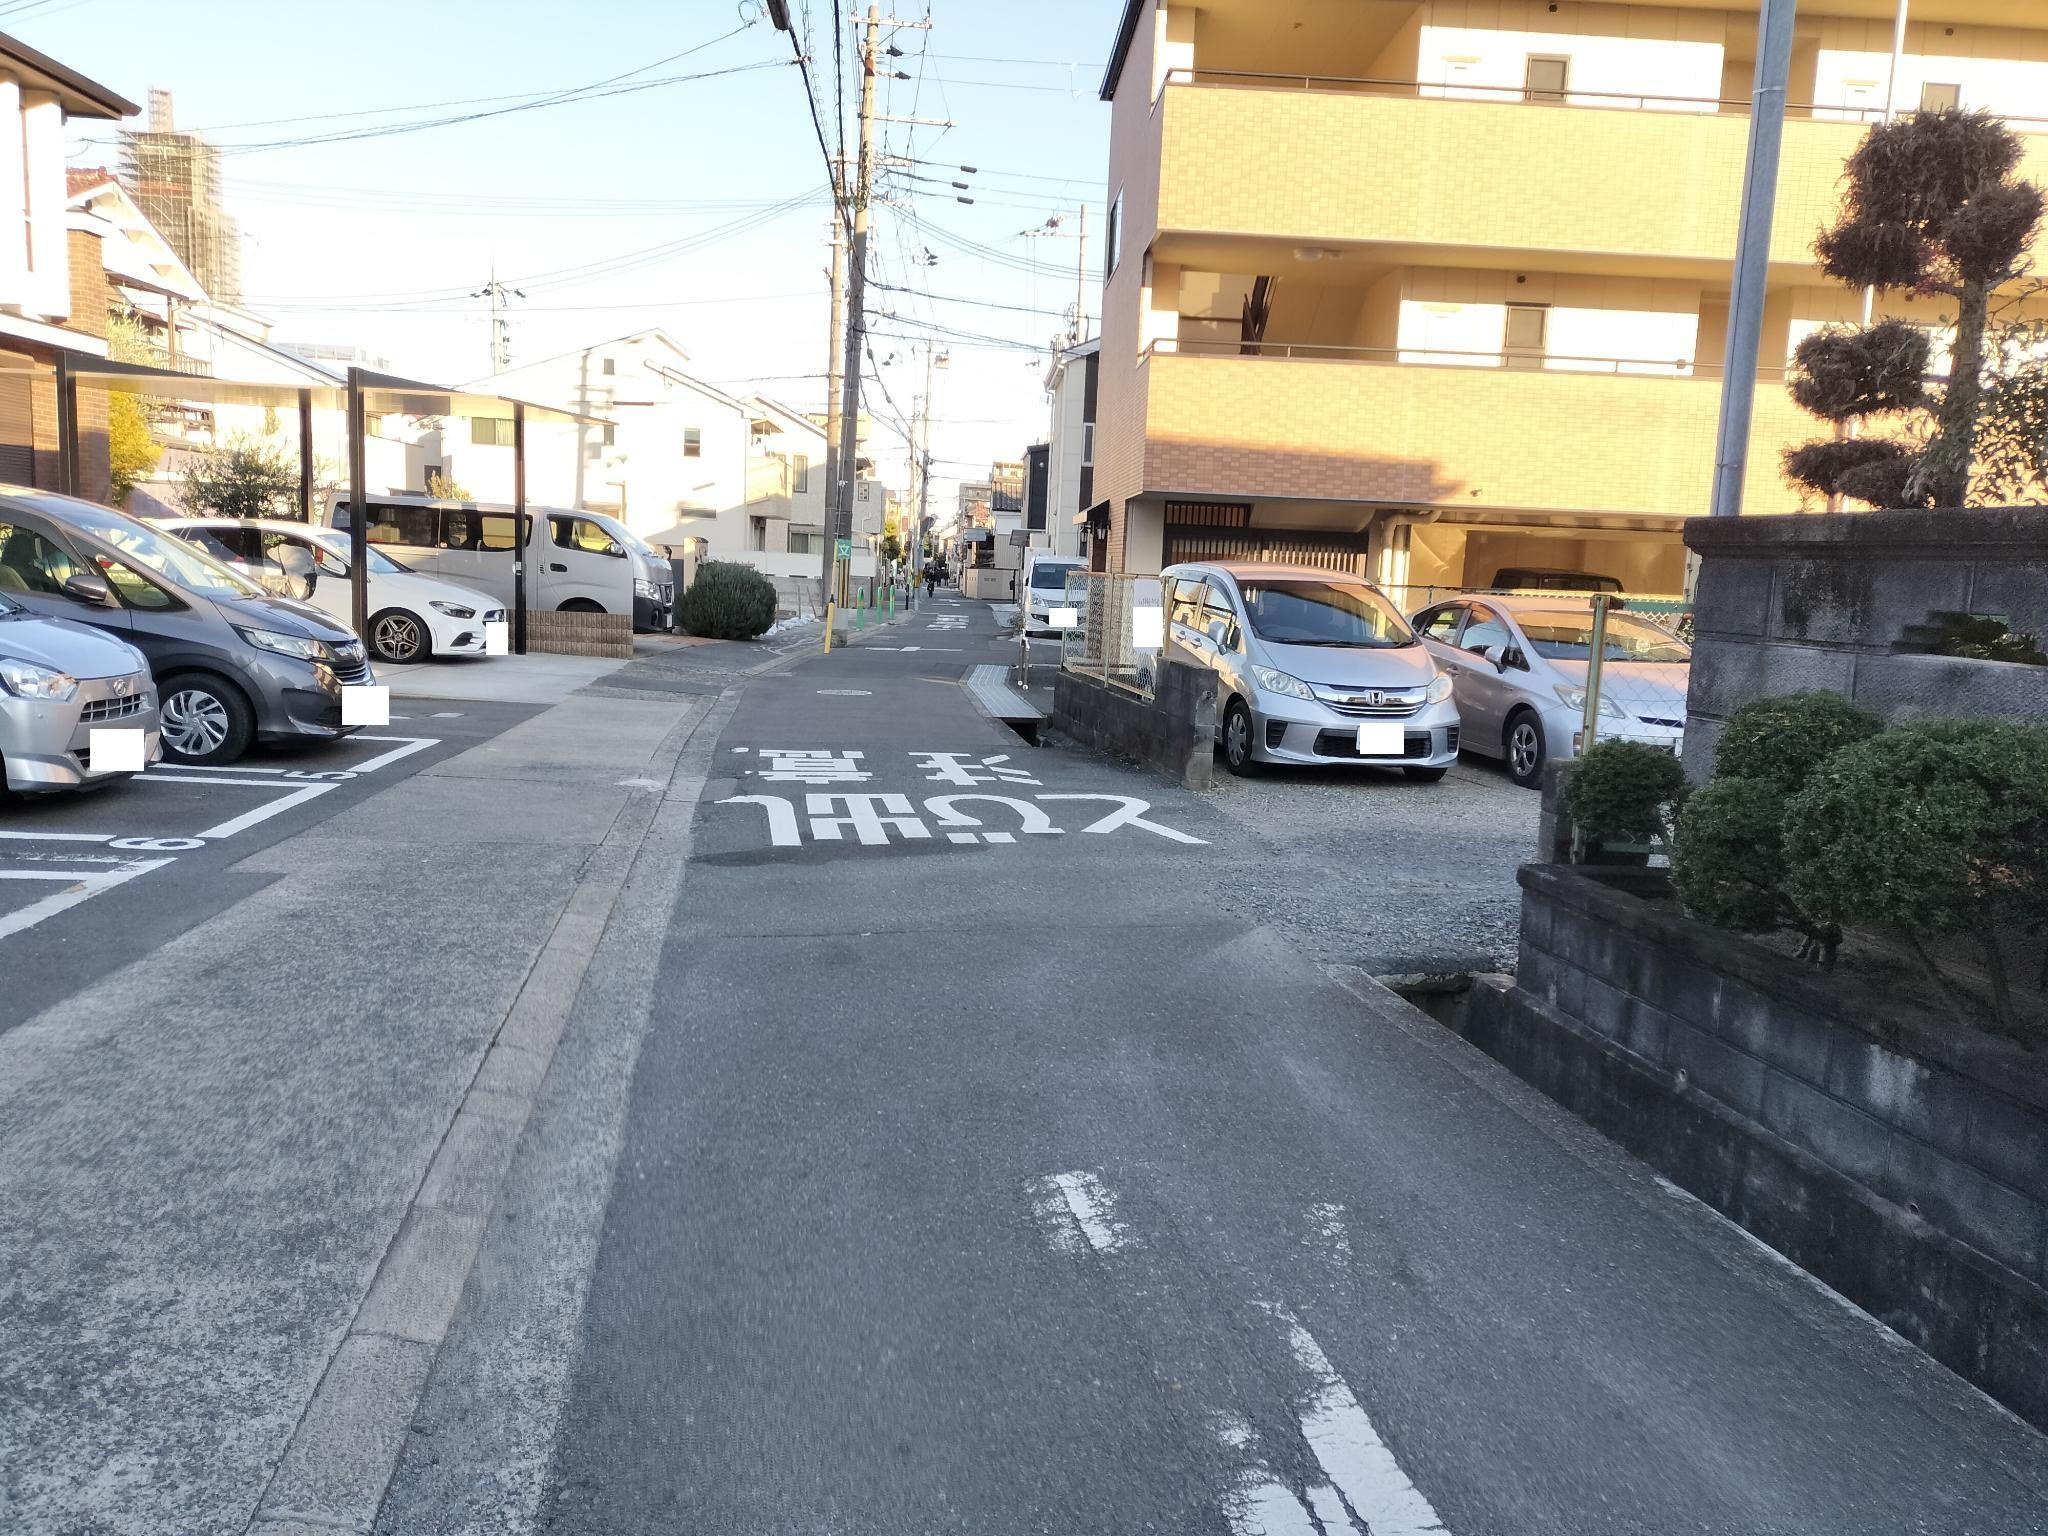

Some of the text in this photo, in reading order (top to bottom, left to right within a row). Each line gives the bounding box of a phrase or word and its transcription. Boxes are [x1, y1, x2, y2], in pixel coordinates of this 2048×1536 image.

[283, 771, 357, 780] 5
[730, 747, 1043, 786] 注意
[714, 793, 1212, 846] とび出し
[109, 837, 206, 850] 6
